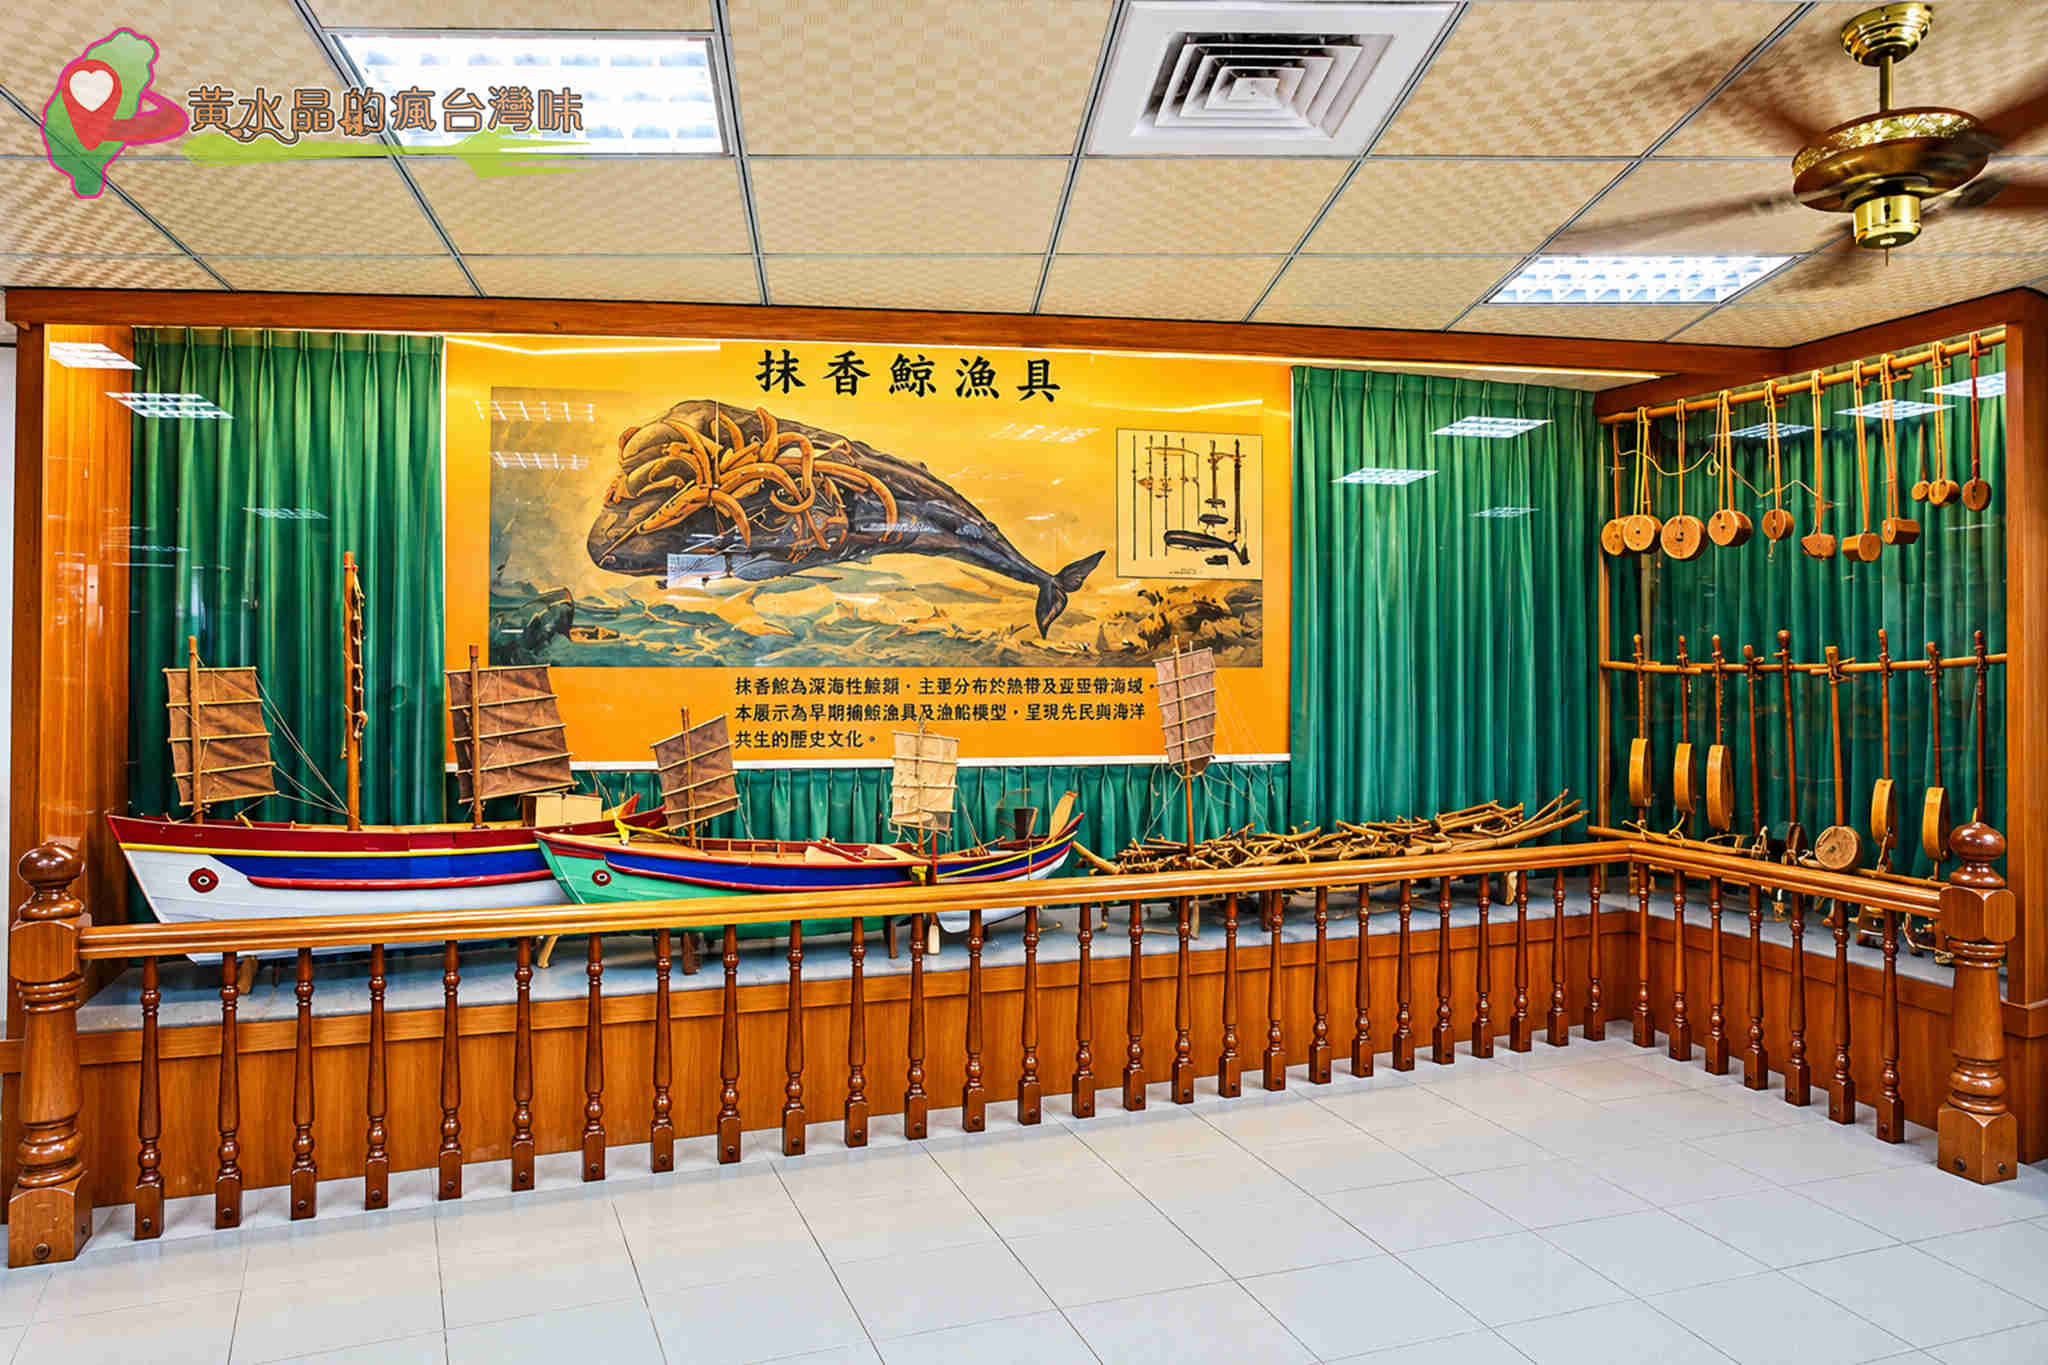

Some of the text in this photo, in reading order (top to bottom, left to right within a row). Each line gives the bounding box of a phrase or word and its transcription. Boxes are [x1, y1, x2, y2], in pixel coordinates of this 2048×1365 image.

[755, 348, 1061, 403] 抹香鯨漁具
[734, 730, 876, 748] 共生的歷史文化。
